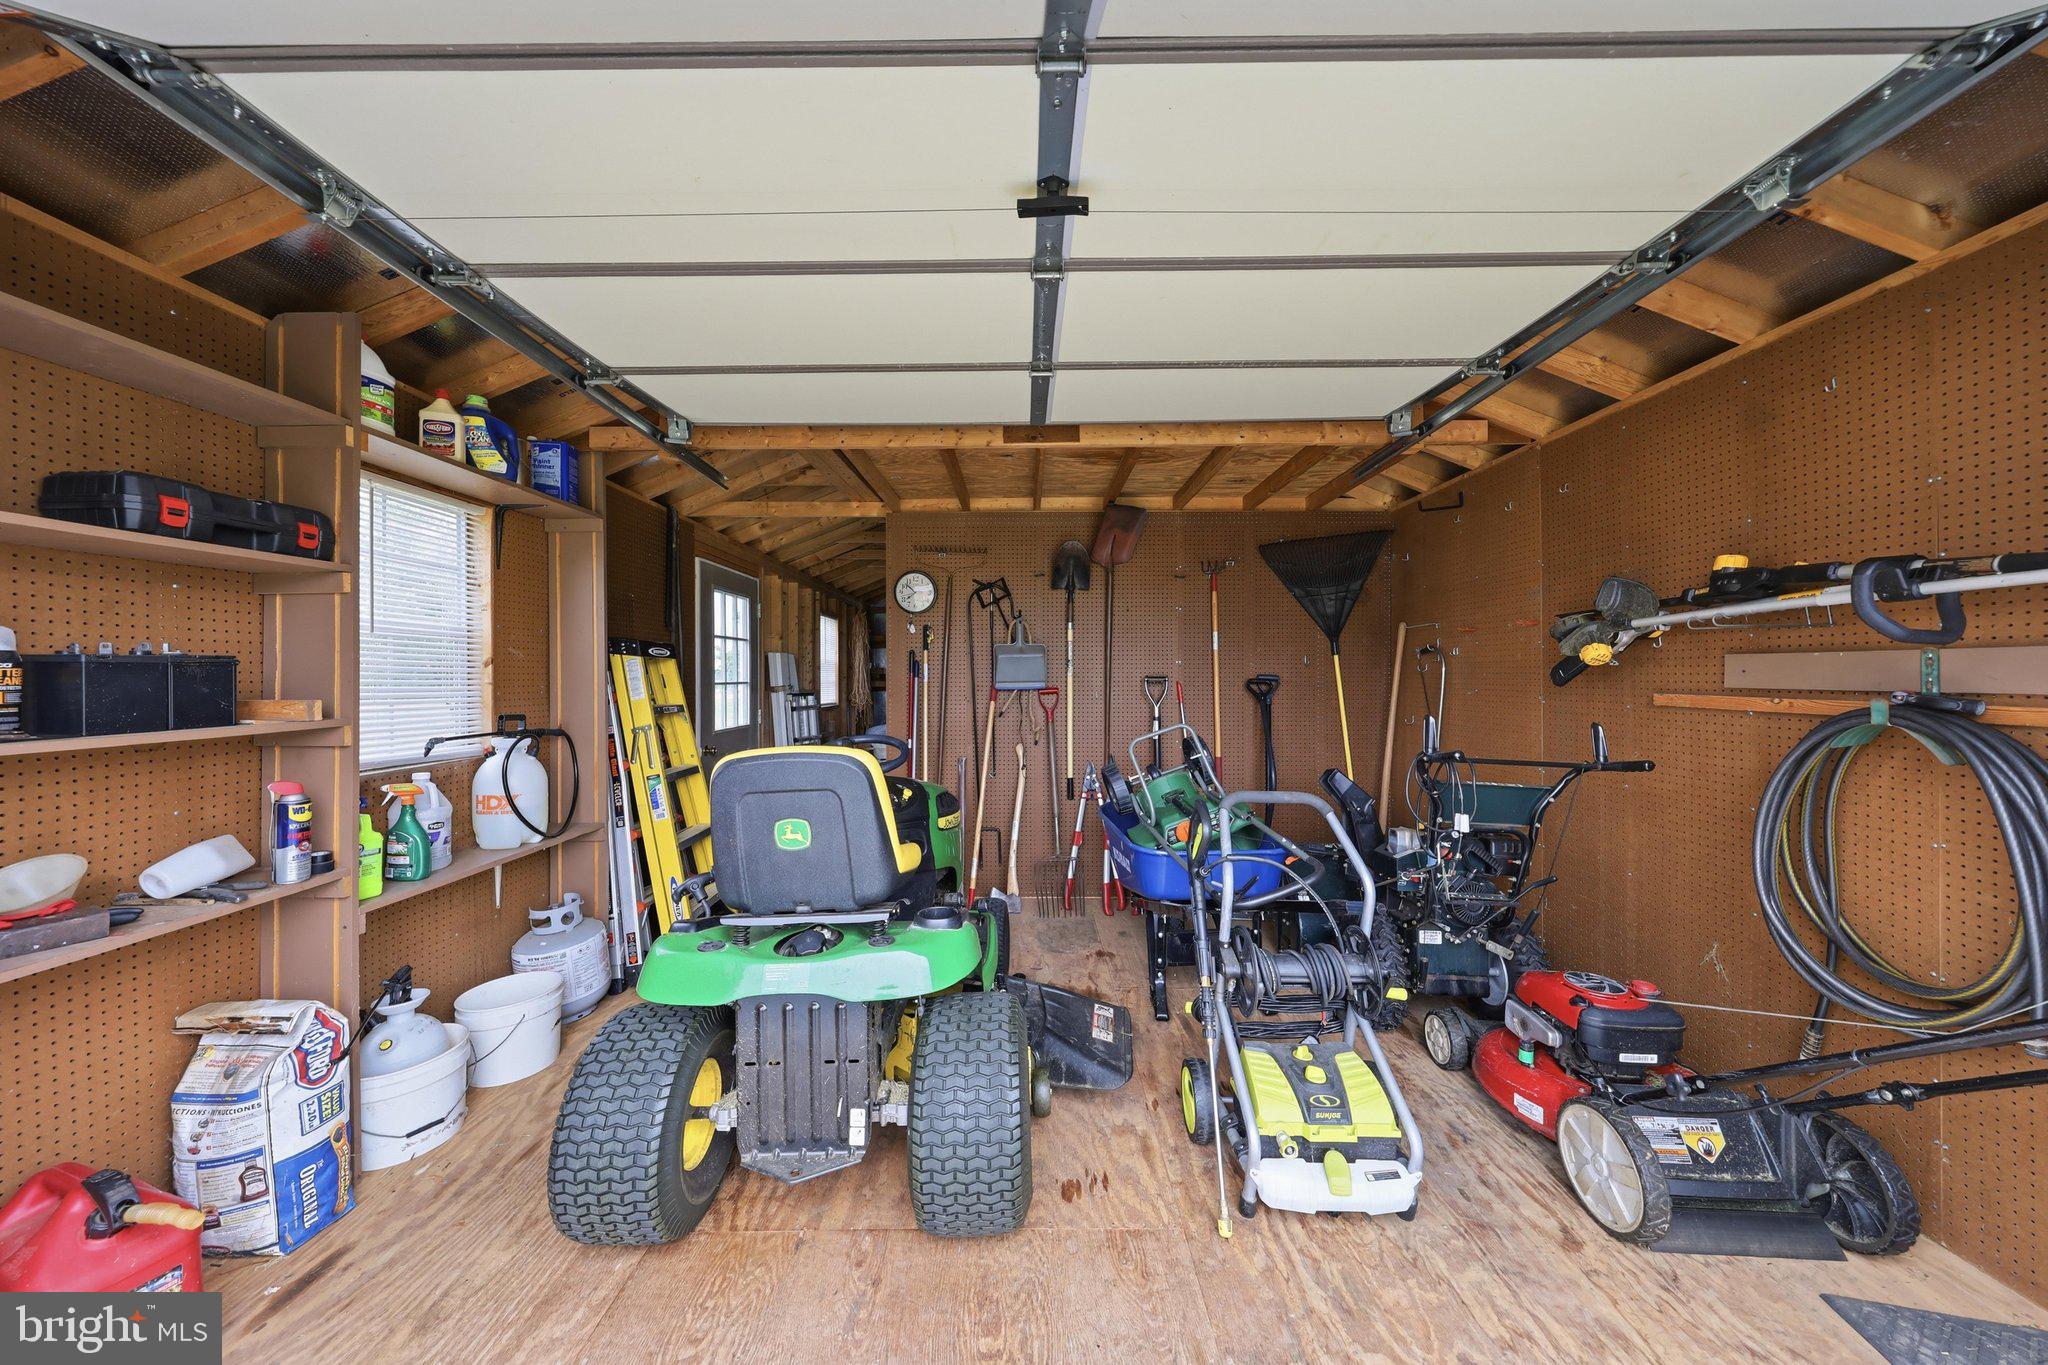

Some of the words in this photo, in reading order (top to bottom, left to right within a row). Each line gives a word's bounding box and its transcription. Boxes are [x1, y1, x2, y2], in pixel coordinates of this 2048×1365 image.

[322, 1092, 332, 1120] SIZE
[333, 1087, 341, 1114] VALUE
[1685, 1124, 1715, 1132] DANGER
[300, 1163, 320, 1229] ORIGINAL
